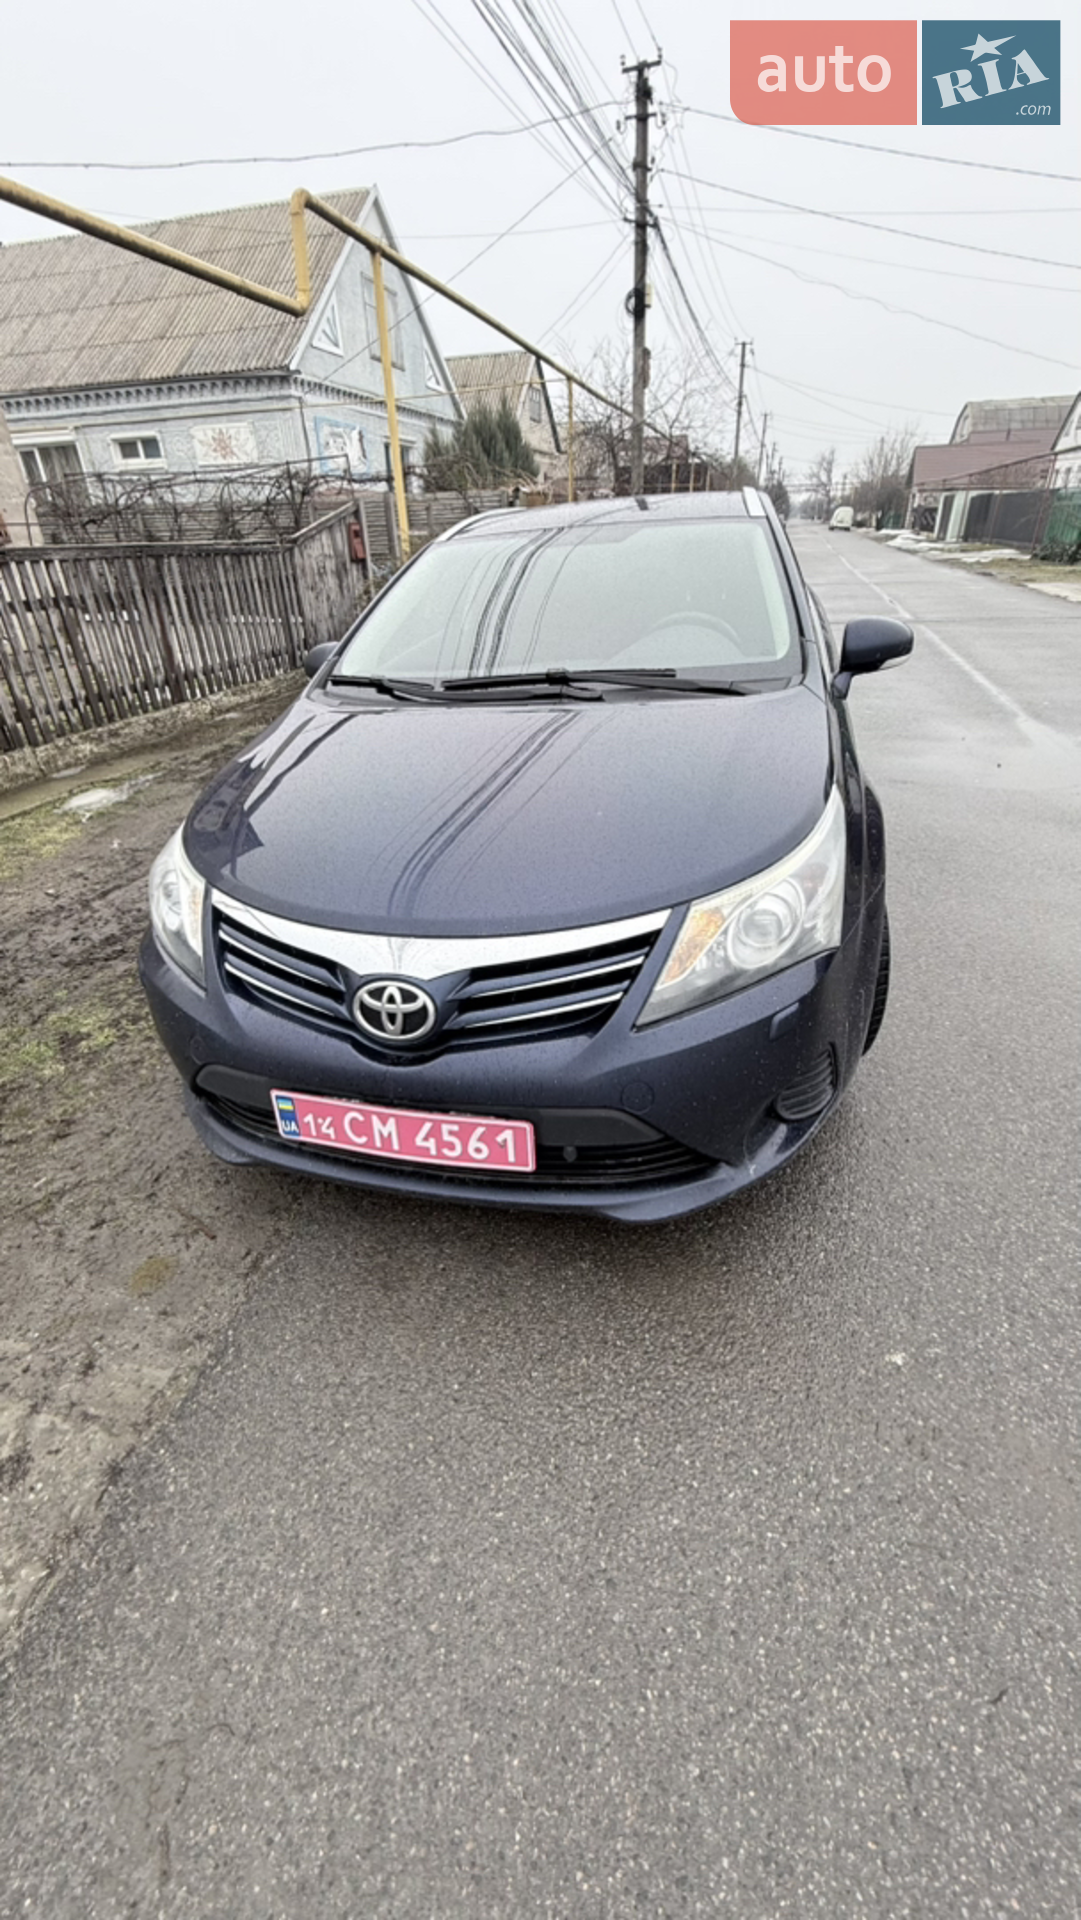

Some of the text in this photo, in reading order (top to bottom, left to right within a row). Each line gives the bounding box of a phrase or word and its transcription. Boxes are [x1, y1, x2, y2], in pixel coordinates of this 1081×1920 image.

[281, 1118, 300, 1134] UA
[303, 1111, 517, 1163] 14 CM 4561
